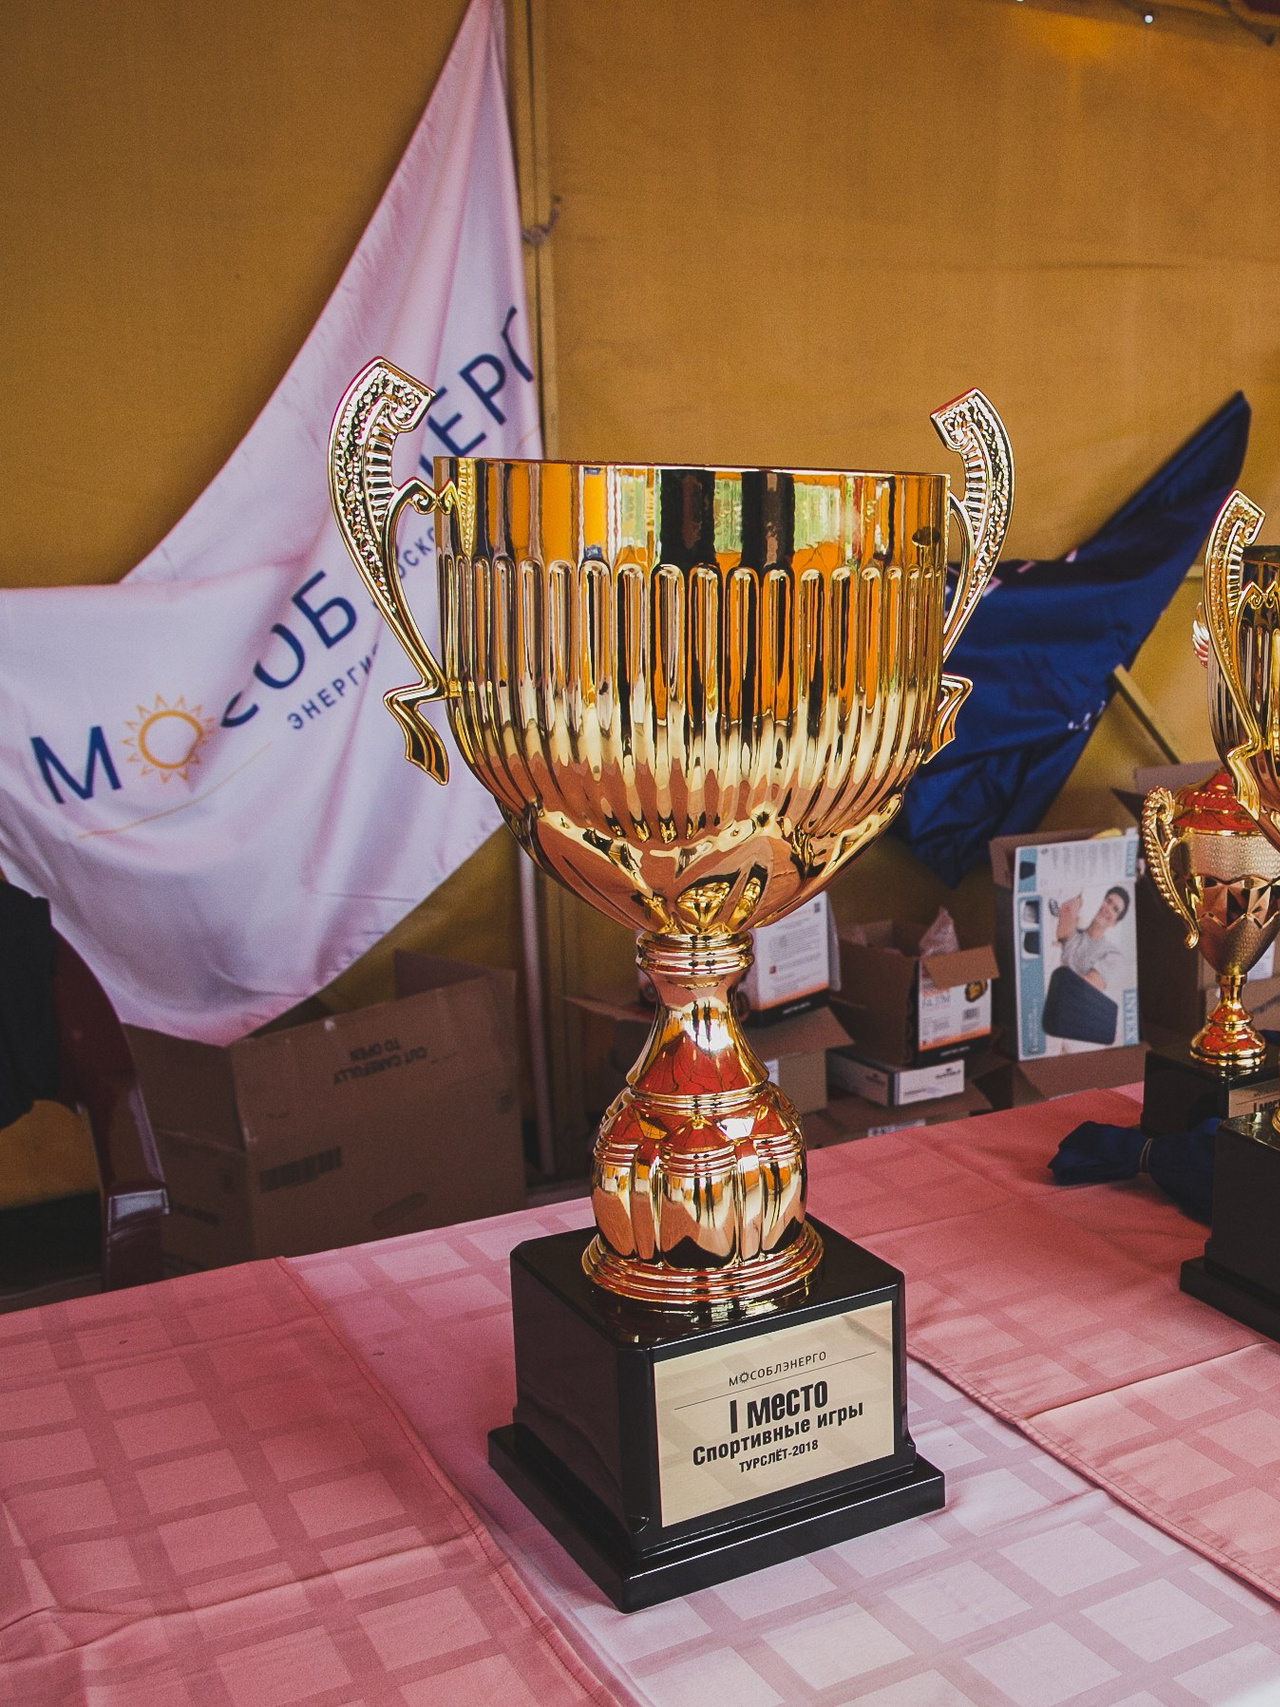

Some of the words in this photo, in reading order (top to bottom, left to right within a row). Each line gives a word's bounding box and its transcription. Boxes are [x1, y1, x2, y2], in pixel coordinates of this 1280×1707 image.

[728, 1350, 828, 1387] МОСОБЛЭНЕРГО
[729, 1399, 737, 1434] I
[746, 1380, 829, 1429] место
[692, 1418, 811, 1467] Спортивные
[817, 1401, 864, 1430] игры
[738, 1439, 819, 1473] ТУРСЛЁТ-2018
